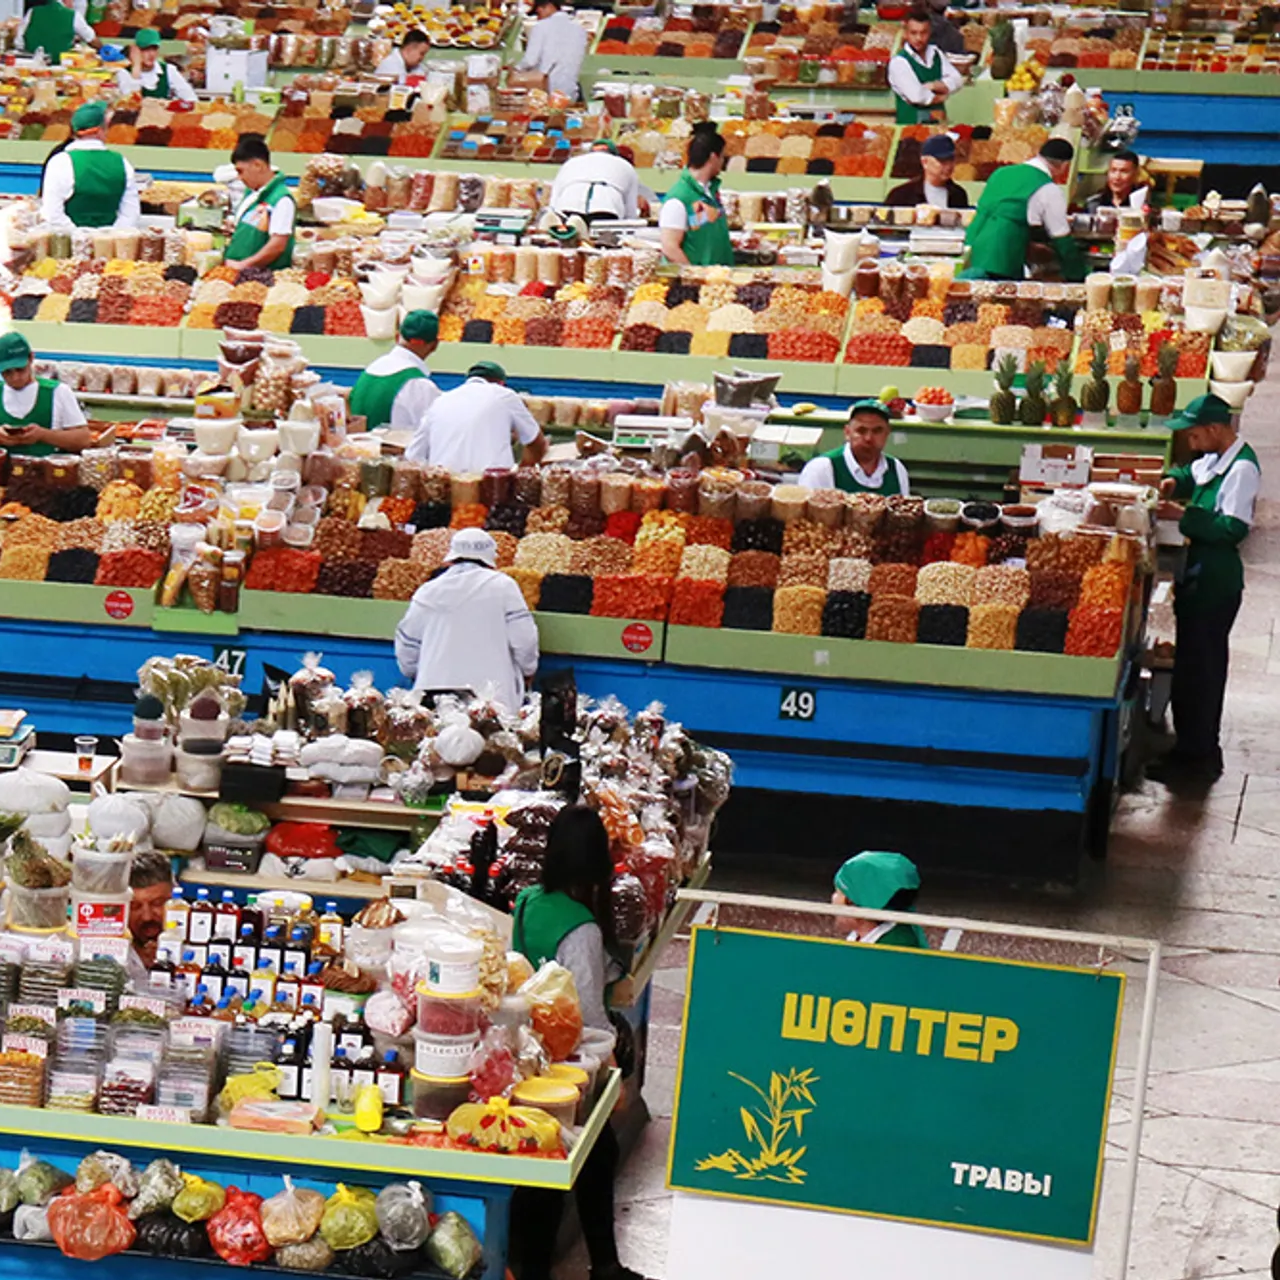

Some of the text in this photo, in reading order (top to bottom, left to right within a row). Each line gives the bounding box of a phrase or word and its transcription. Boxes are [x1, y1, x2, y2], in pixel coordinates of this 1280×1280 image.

[215, 649, 246, 676] 47
[780, 691, 815, 719] 49
[780, 992, 1019, 1063] ШӨПТЕР
[951, 1161, 1052, 1197] ТРАВЫ
